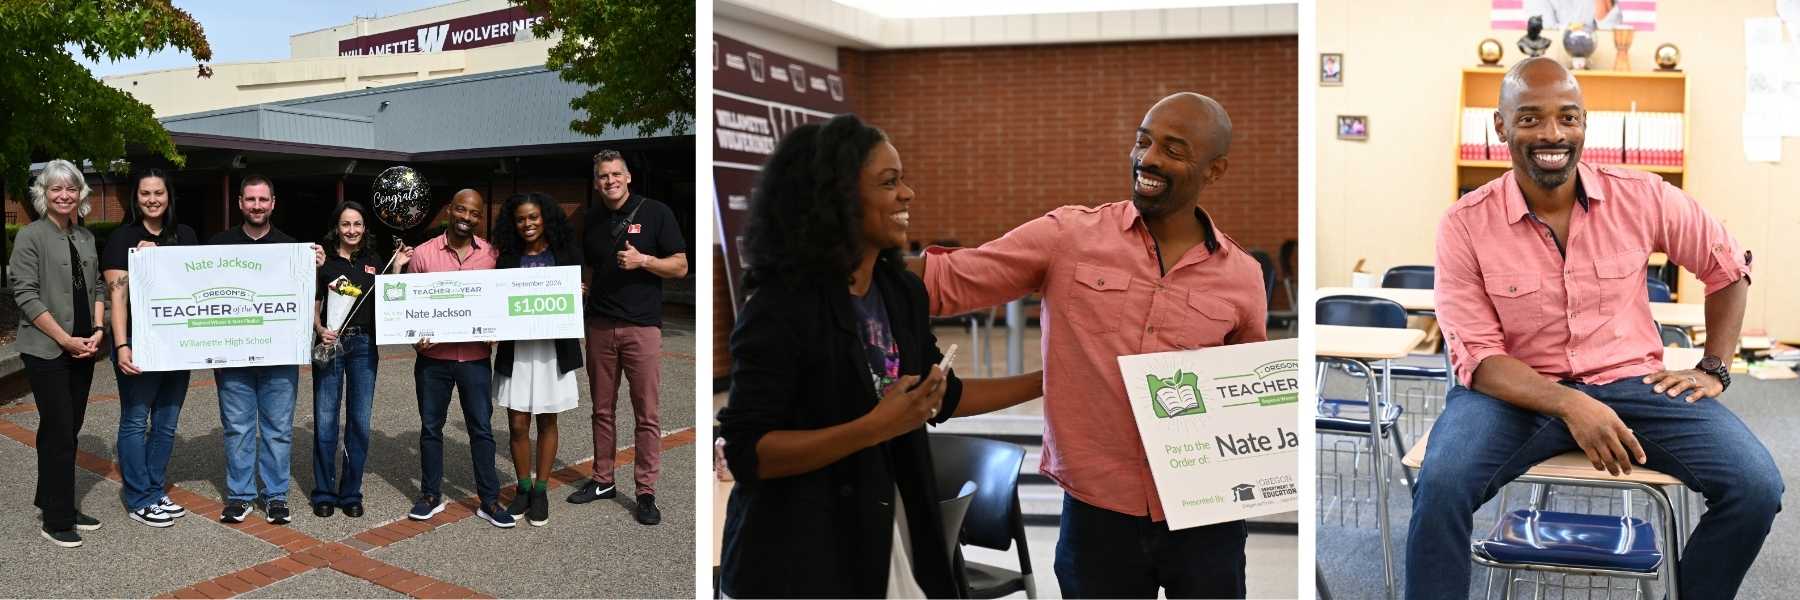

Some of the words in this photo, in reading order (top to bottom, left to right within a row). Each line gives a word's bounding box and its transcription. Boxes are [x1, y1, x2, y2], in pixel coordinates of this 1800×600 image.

[451, 16, 545, 45] WOLVERINES
[373, 184, 420, 212] Congrats
[184, 260, 214, 273] Nate
[216, 257, 263, 271] Jackson
[412, 287, 451, 295] TEACHER
[511, 280, 544, 289] September
[545, 279, 562, 287] 2026
[202, 289, 247, 298] OREGON'S
[151, 304, 232, 318] TEACHER
[233, 305, 241, 315] of
[242, 304, 253, 313] the
[252, 302, 297, 314] YEAR
[513, 296, 567, 315] $1,000
[405, 309, 430, 319] Nate
[431, 307, 472, 318] Jackson
[179, 339, 223, 348] Willamette
[225, 338, 244, 347] High
[245, 336, 272, 345] School
[1216, 377, 1299, 399] TEACHER
[1165, 444, 1182, 455] Pay
[1183, 443, 1194, 452] to
[1195, 440, 1210, 451] the
[1215, 432, 1272, 458] Nate
[1169, 455, 1196, 469] Order
[1198, 454, 1211, 465] of:
[1258, 474, 1293, 487] OREGON
[1260, 484, 1289, 493] DEPARTMENT
[1262, 487, 1298, 499] EDUCATION
[1181, 496, 1214, 507] Presented
[1214, 495, 1227, 504] By:
